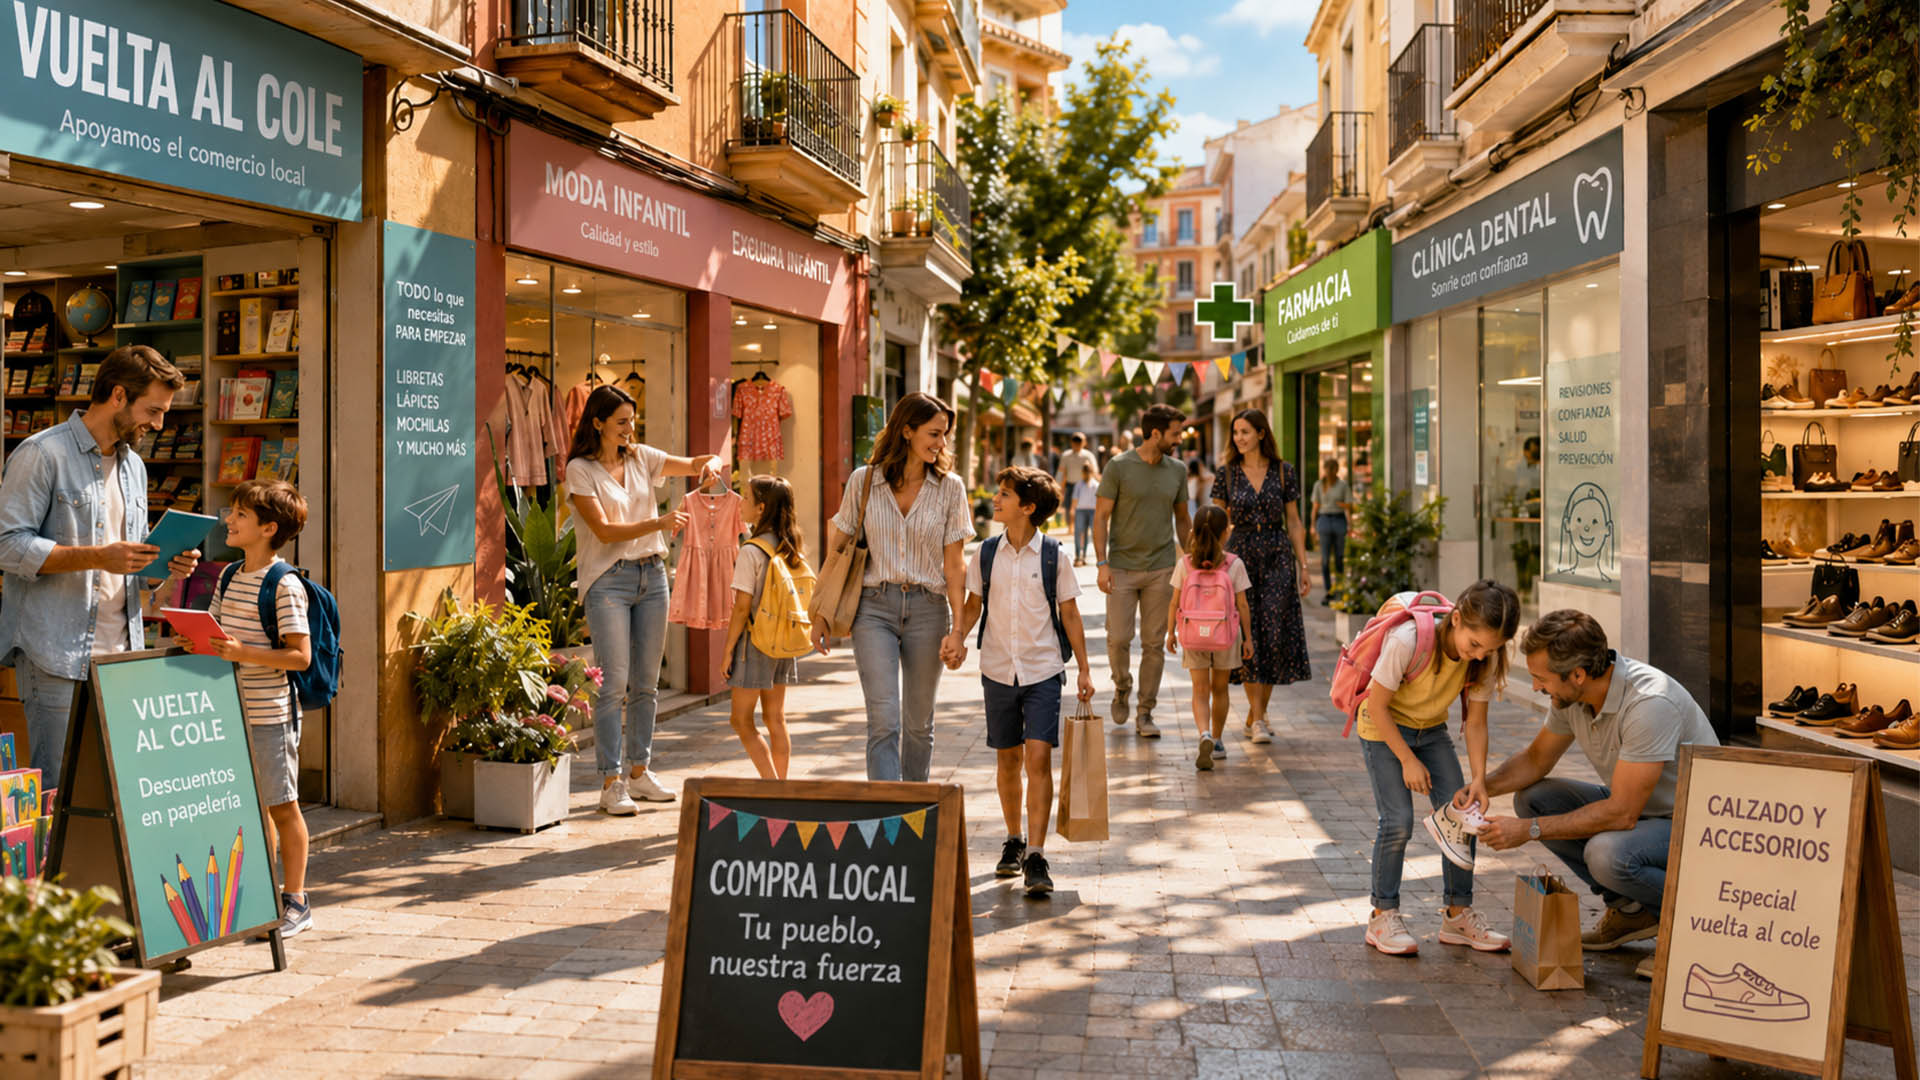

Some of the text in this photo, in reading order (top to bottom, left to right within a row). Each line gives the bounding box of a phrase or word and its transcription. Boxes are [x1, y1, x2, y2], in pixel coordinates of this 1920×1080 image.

[14, 1, 343, 157] VUELTA AL COLE
[59, 108, 306, 187] Apoyamos el comercio local
[545, 161, 691, 238] MODA INFANTIL
[580, 221, 660, 258] Calidad y estilo
[1411, 192, 1557, 279] CLÍNICA DENTAL
[1461, 273, 1478, 288] con
[1479, 251, 1529, 281] confianza
[396, 280, 465, 307] TODO lo que
[1278, 268, 1352, 326] FARMACIA
[407, 307, 455, 325] necesitas
[1287, 312, 1338, 344] Cuidamos de ti
[395, 325, 466, 347] PARA EMPEZAR
[396, 369, 444, 387] LIBRETAS
[1559, 382, 1612, 399] REVISIONES
[396, 391, 440, 410] LÁPICES
[1558, 406, 1611, 422] CONFIANZA
[396, 416, 450, 433] MOCHILAS
[1559, 431, 1588, 444] SALUD
[396, 438, 467, 456] Y MUCHO MÁS
[1558, 450, 1614, 465] PREVENCIÓN
[132, 690, 215, 721] VUELTA
[136, 718, 226, 753] AL COLE
[138, 768, 236, 799] Descuentos
[141, 790, 242, 828] en papelería
[1707, 794, 1828, 829] CALZADO Y
[1699, 826, 1830, 863] ACCESORIOS
[709, 859, 916, 904] COMPRA LOCAL
[1718, 880, 1797, 912] Especial
[738, 912, 882, 950] Tu pueblo,
[1690, 914, 1821, 950] vuelta al cole
[709, 953, 902, 983] nuestra fuerza
